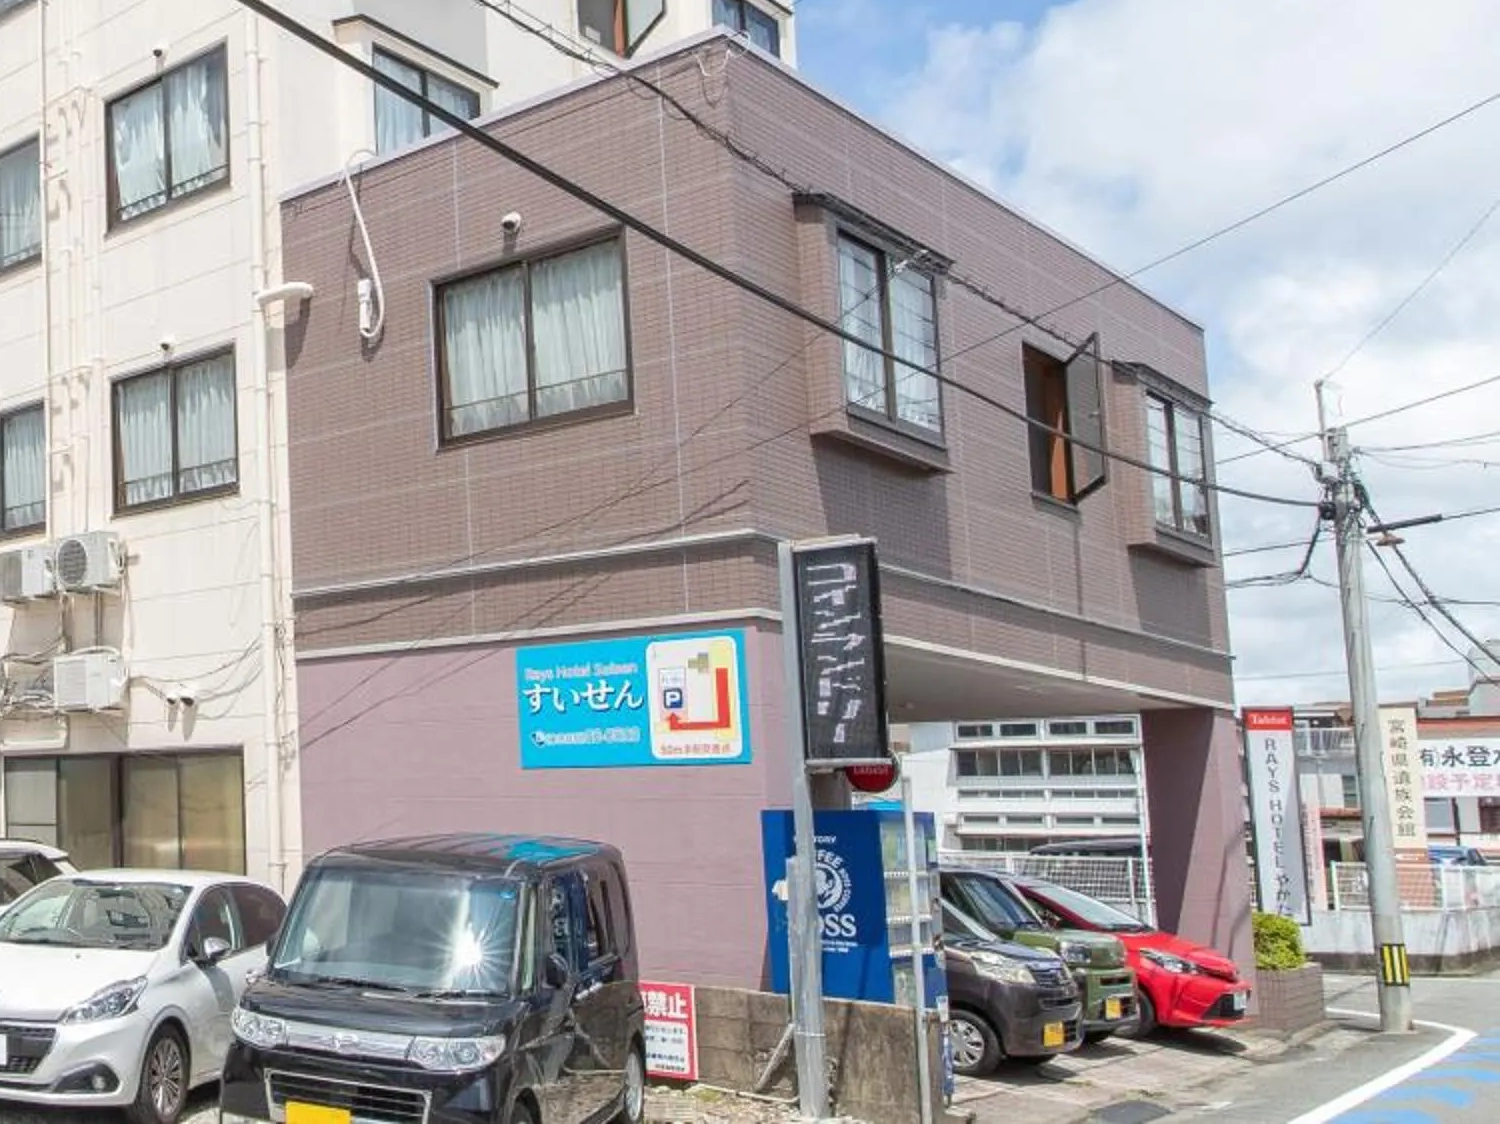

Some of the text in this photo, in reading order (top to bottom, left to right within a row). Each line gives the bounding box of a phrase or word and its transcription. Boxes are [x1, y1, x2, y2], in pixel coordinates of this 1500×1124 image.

[523, 679, 644, 715] すいせん
[1264, 738, 1281, 794] RAYS
[1269, 799, 1285, 870] HOTEL
[817, 849, 844, 869] FEE
[818, 913, 857, 937] SS
